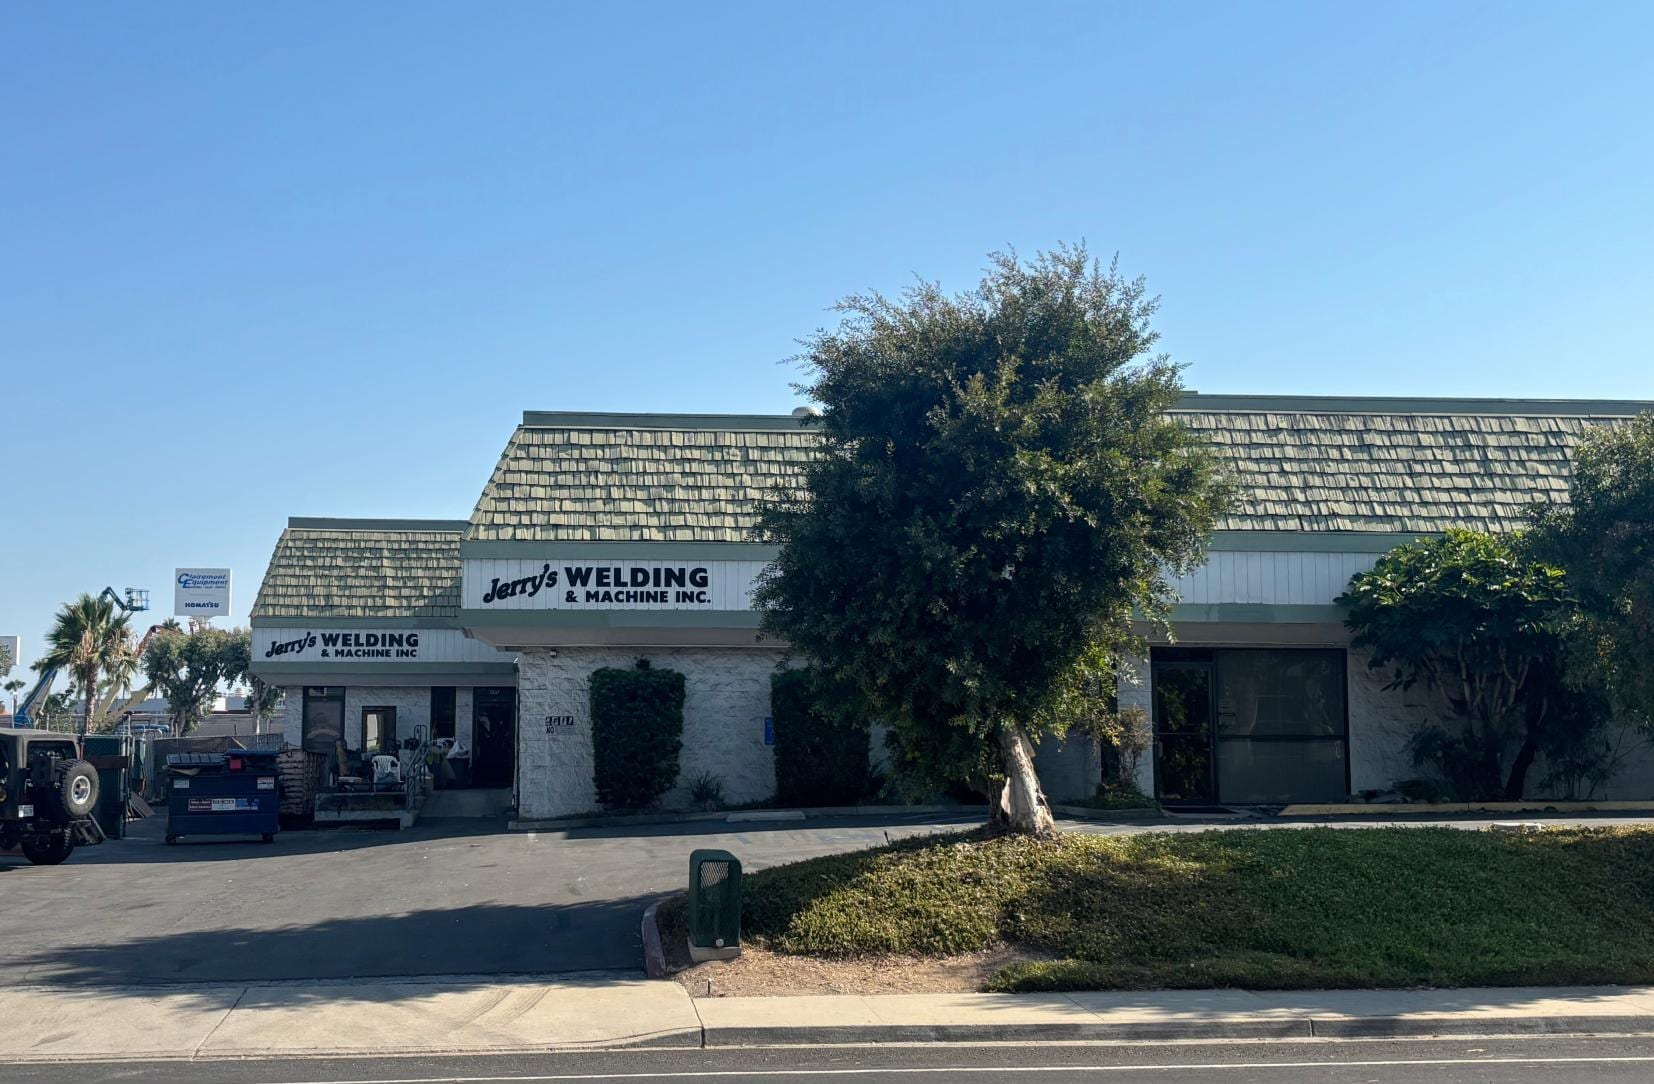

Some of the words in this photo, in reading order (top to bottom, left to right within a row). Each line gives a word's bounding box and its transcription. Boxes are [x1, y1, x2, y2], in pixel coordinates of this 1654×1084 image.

[178, 573, 227, 584] Clairemont
[483, 563, 558, 603] Jerry's
[564, 567, 709, 588] WELDING
[182, 580, 228, 589] Equipment
[565, 591, 579, 603] &
[585, 591, 669, 603] MACHINE
[675, 591, 712, 603] INC.
[265, 631, 317, 658] Jerry's
[320, 633, 419, 648] WELDING
[320, 649, 330, 658] &
[334, 649, 392, 658] MACHINE
[396, 649, 418, 658] INC
